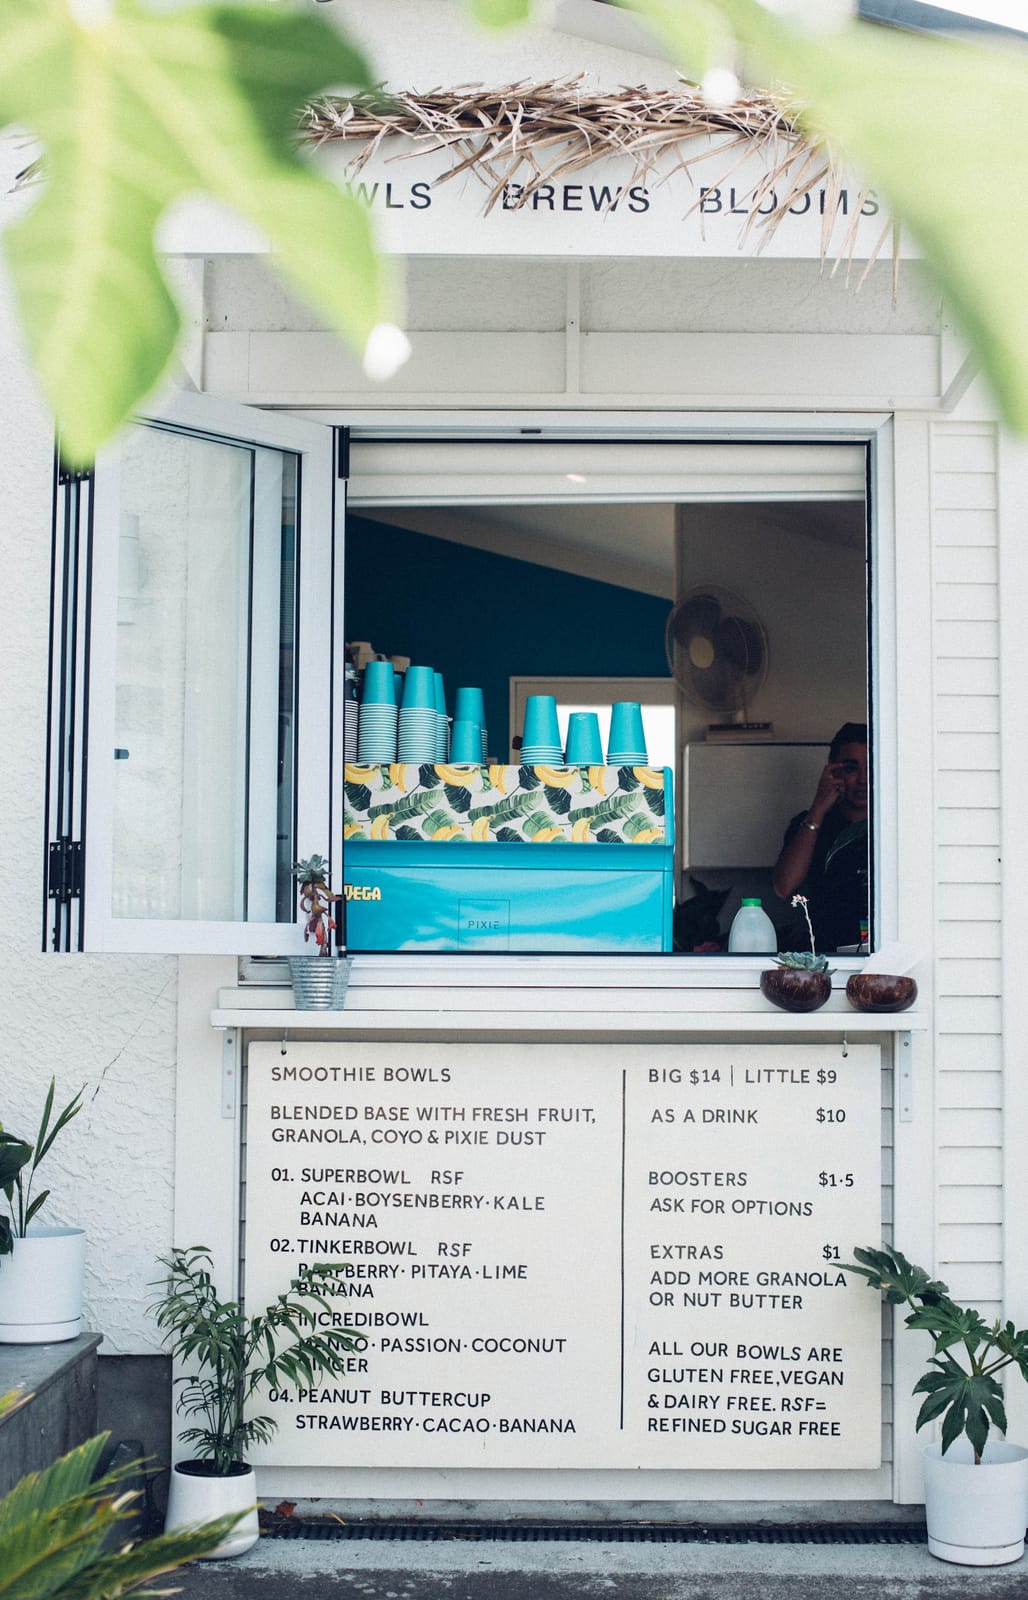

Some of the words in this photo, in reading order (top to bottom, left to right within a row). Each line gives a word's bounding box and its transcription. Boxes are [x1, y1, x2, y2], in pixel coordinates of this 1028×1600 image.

[342, 182, 432, 209] WLS
[502, 183, 650, 213] BREWS
[467, 919, 500, 930] PIXIE
[271, 1066, 376, 1082] SMOOTHIE
[383, 1067, 451, 1083] BOWLS
[648, 1068, 682, 1084] BIG
[689, 1068, 721, 1086] $14
[745, 1068, 810, 1084] LITTLE
[816, 1068, 837, 1086] $9
[270, 1105, 358, 1121] BLENDED
[364, 1106, 410, 1122] BASE
[416, 1106, 465, 1122] WITH
[472, 1107, 528, 1123] FRESH
[538, 1108, 596, 1124] FRUIT,
[651, 1108, 675, 1123] AS
[683, 1109, 696, 1123] A
[702, 1108, 758, 1124] DRINK
[815, 1106, 846, 1124] $10
[271, 1127, 367, 1145] GRANOLA,
[371, 1129, 423, 1145] COYO
[427, 1129, 439, 1144] &
[444, 1130, 489, 1145] PIXIE
[496, 1131, 547, 1146] DUST
[271, 1167, 295, 1182] 01.
[300, 1167, 411, 1185] SUPERBOWL
[431, 1170, 464, 1186] RSF
[648, 1170, 748, 1187] BOOSTERS
[493, 1195, 545, 1211] KALE
[649, 1197, 685, 1213] ASK
[691, 1199, 725, 1214] FOR
[731, 1199, 813, 1217] OPTIONS
[300, 1211, 378, 1229] BANANA
[269, 1238, 295, 1253] 02.
[296, 1238, 418, 1256] TINKERBOWL
[437, 1241, 473, 1258] RSF
[650, 1244, 724, 1260] EXTRAS
[822, 1243, 841, 1261] $1
[482, 1264, 528, 1280] LIME
[650, 1270, 691, 1286] ADD
[698, 1270, 750, 1286] MORE
[756, 1271, 848, 1287] GRANOLA
[298, 1282, 376, 1299] BANANA
[649, 1291, 675, 1307] OR
[683, 1292, 723, 1308] NUT
[729, 1293, 803, 1310] BUTTER
[471, 1337, 567, 1353] COCONUT
[648, 1341, 684, 1356] ALL
[690, 1341, 729, 1358] OUR
[736, 1344, 802, 1362] BOWLS
[807, 1347, 843, 1363] ARE
[300, 1357, 369, 1374] IGER
[647, 1367, 724, 1384] GLUTEN
[780, 1370, 844, 1386] VEGAN
[268, 1387, 294, 1403] 04.
[298, 1387, 372, 1405] PEANUT
[380, 1390, 491, 1408] BUTTERCUP
[647, 1393, 660, 1409] &
[664, 1394, 721, 1410] DAIRY
[726, 1396, 777, 1412] FREE.
[499, 1418, 577, 1434] BANANA
[647, 1417, 727, 1434] REFINED
[730, 1419, 792, 1436] SUGAR
[798, 1421, 841, 1437] FREE
